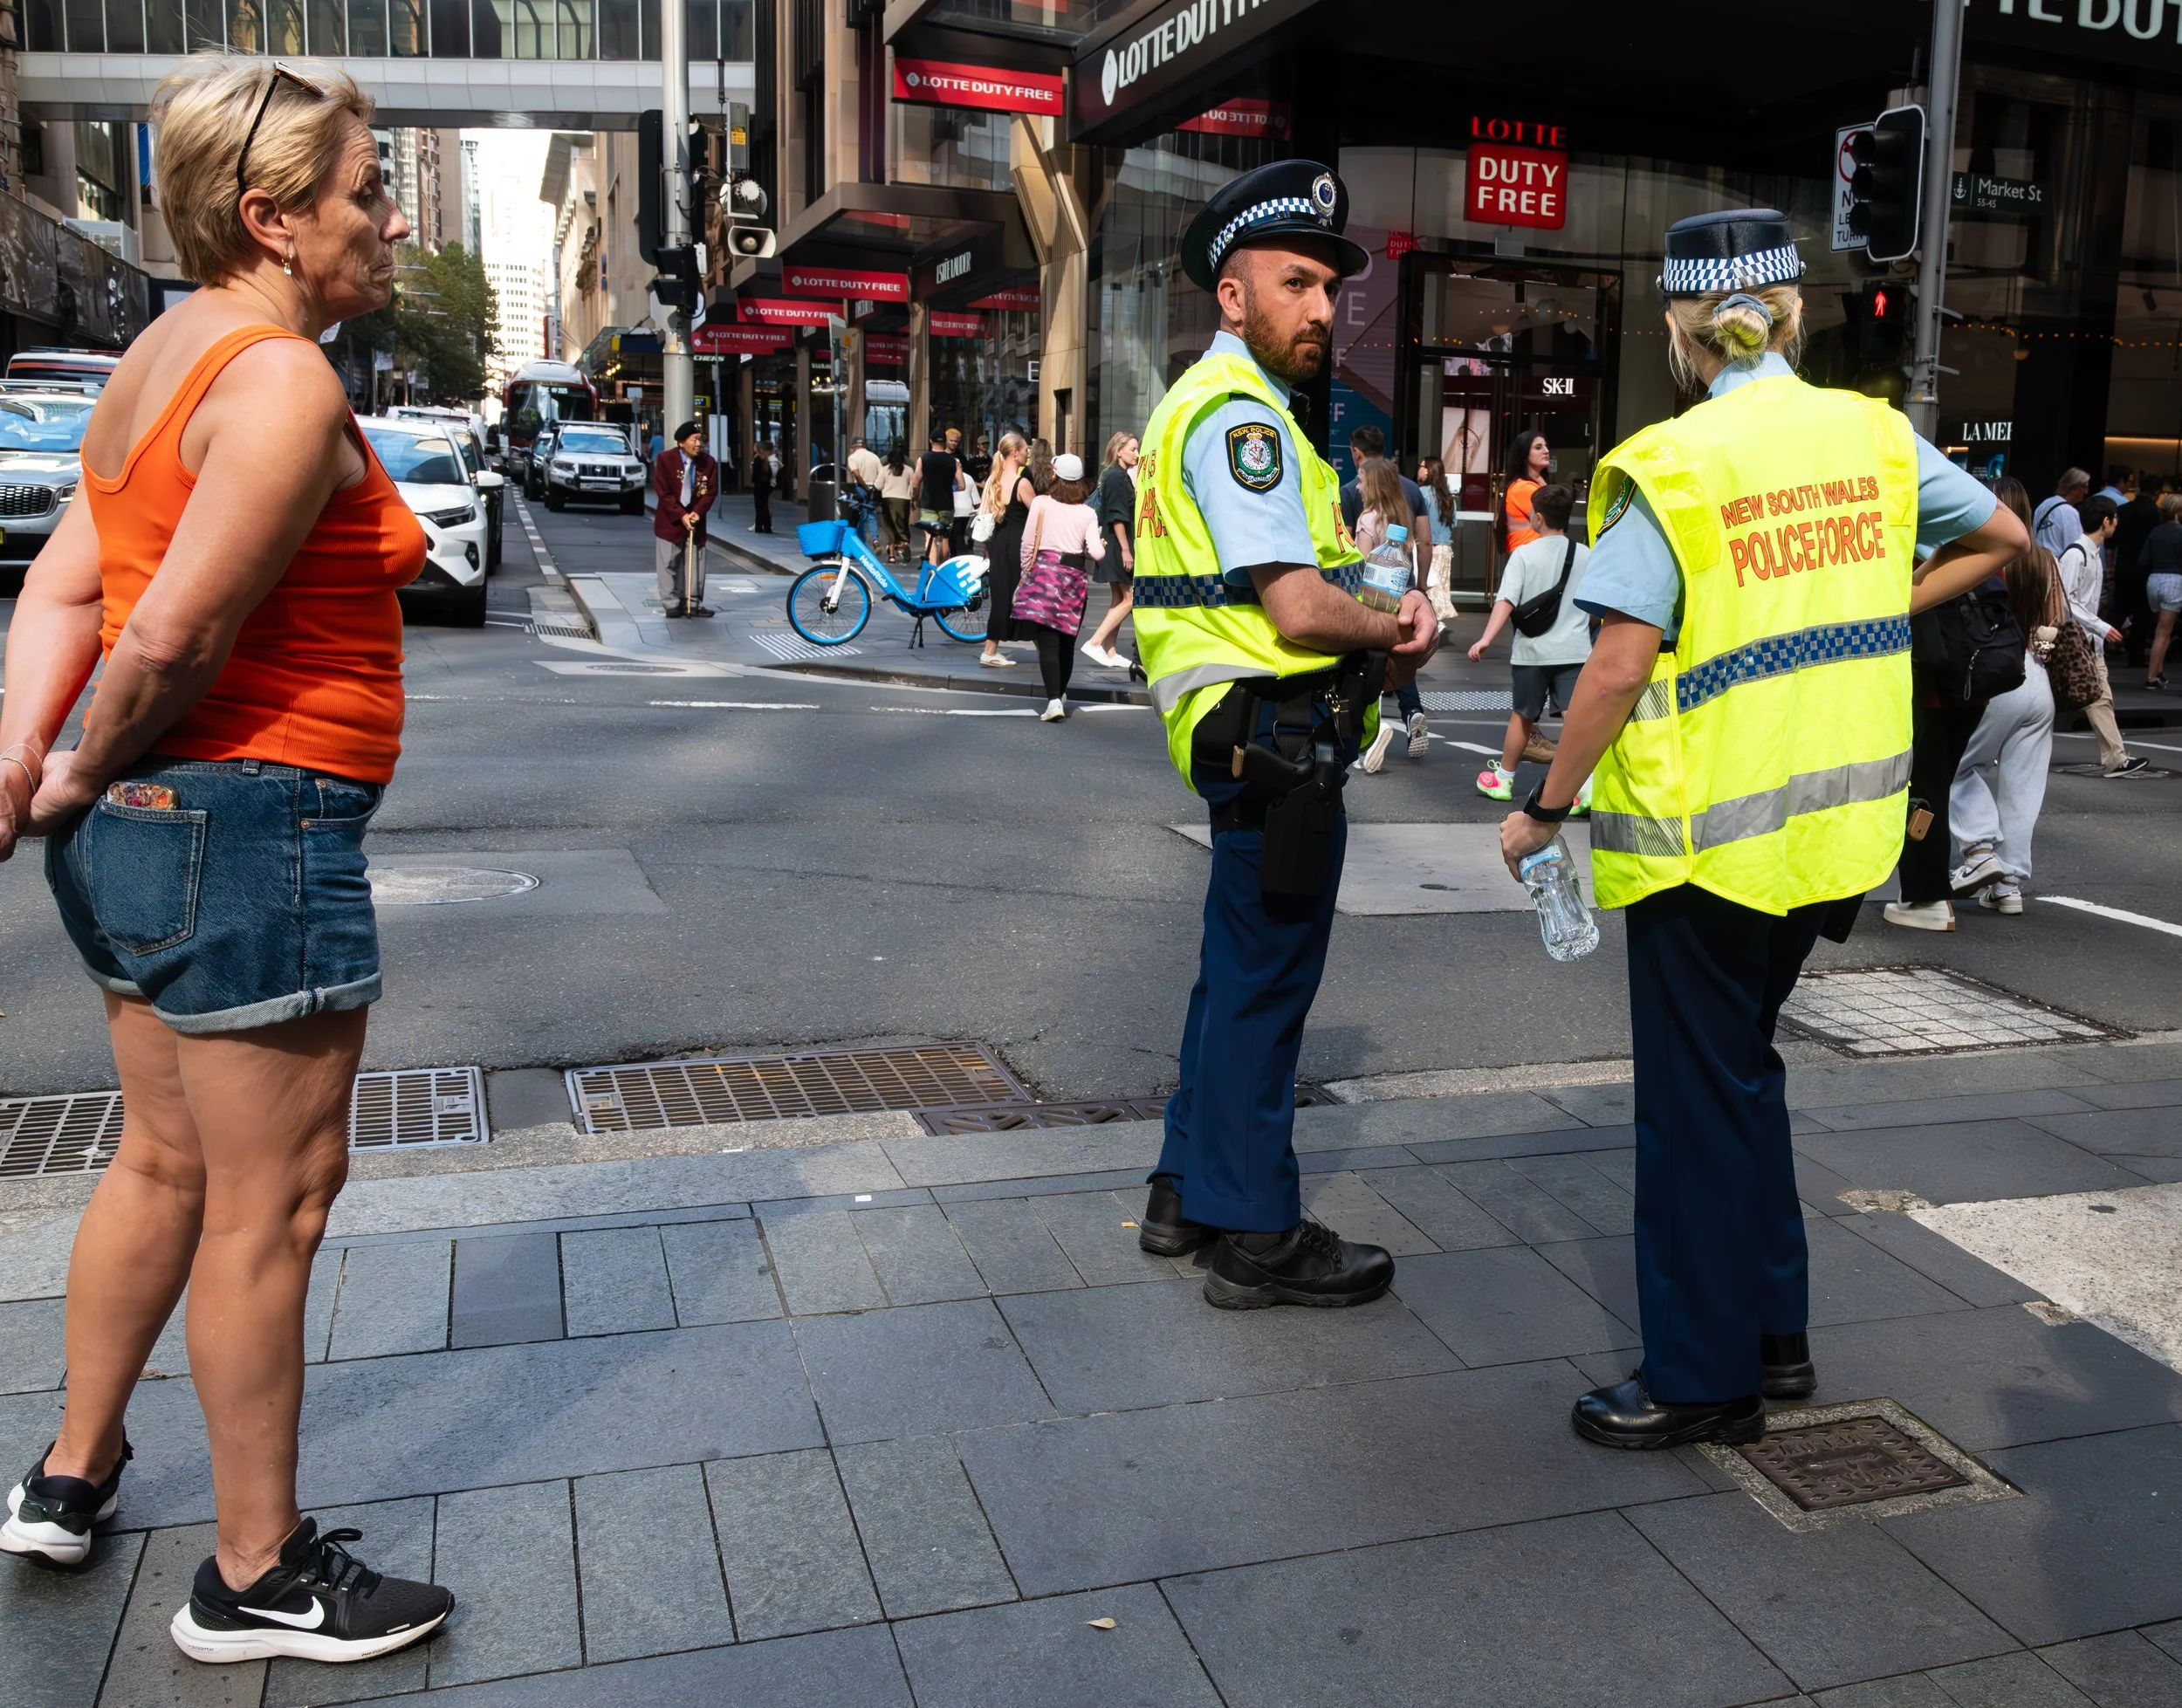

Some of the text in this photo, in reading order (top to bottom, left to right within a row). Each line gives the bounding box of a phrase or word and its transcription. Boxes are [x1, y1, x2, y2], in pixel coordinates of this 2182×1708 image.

[1118, 17, 1176, 88] LOTTE
[923, 76, 1053, 101] LOTTE DUTY FREE
[1471, 116, 1568, 147] LOTTE
[1479, 156, 1560, 188] DUTY
[1477, 186, 1556, 217] FREE
[1842, 189, 1856, 208] N
[1978, 177, 2042, 202] Market St
[1977, 197, 1997, 209] 55-45
[803, 278, 901, 292] LOTTE DUTY FREE
[754, 307, 786, 317] LOTTE
[786, 309, 813, 318] DUTY
[1542, 377, 1575, 394] SK-II
[1250, 427, 1275, 438] POLICE
[1962, 422, 1981, 441] LA
[1720, 476, 1879, 529] NEW SOUTH WALES
[1728, 511, 1886, 587] POLICE FORCE
[859, 554, 889, 588] HelloRide
